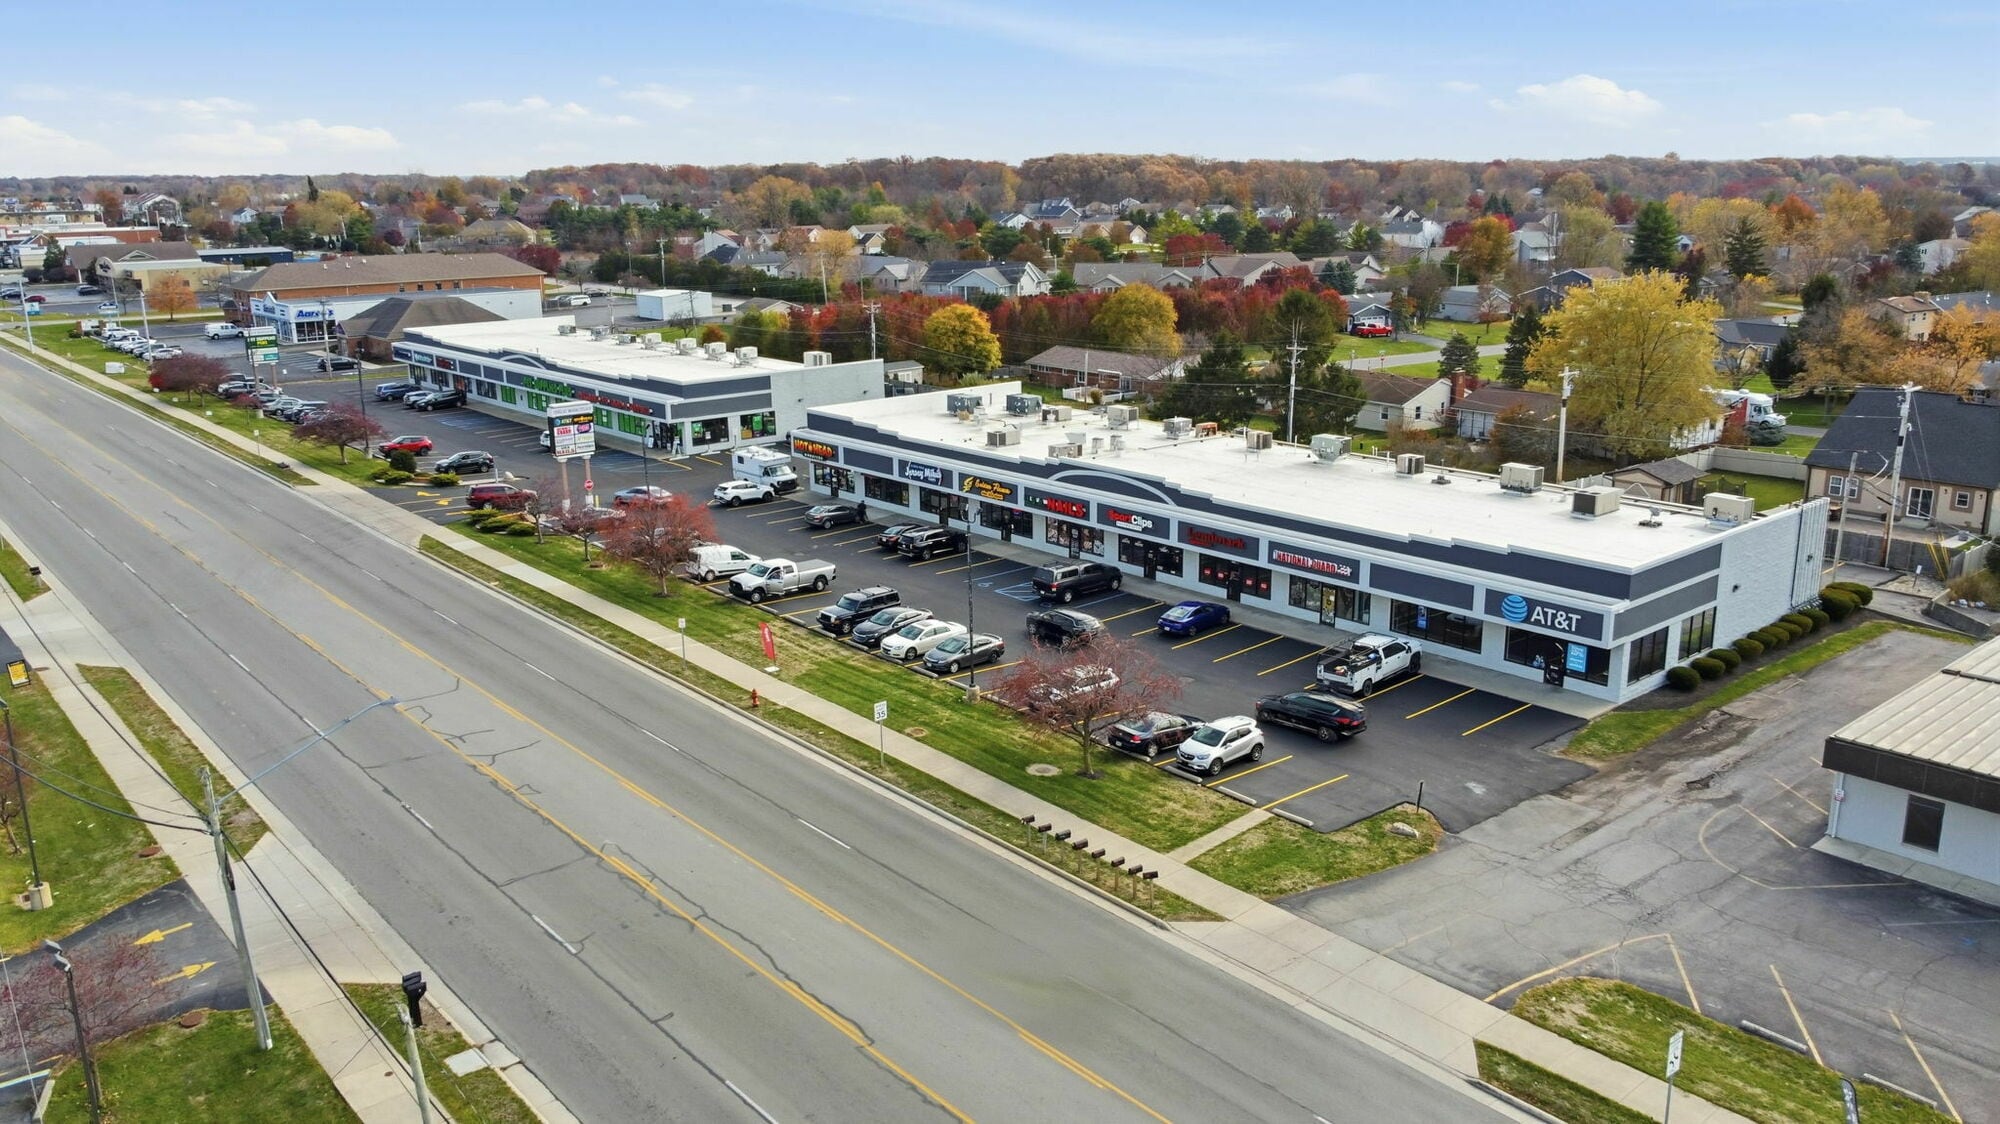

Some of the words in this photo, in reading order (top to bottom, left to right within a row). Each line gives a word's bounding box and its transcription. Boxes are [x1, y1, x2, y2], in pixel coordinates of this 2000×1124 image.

[794, 439, 809, 450] HOT
[812, 443, 833, 458] HEAD
[1046, 497, 1084, 518] NAILS
[1273, 550, 1311, 567] NATIONAL
[1312, 558, 1338, 573] GUARD
[1530, 606, 1581, 632] AT&T
